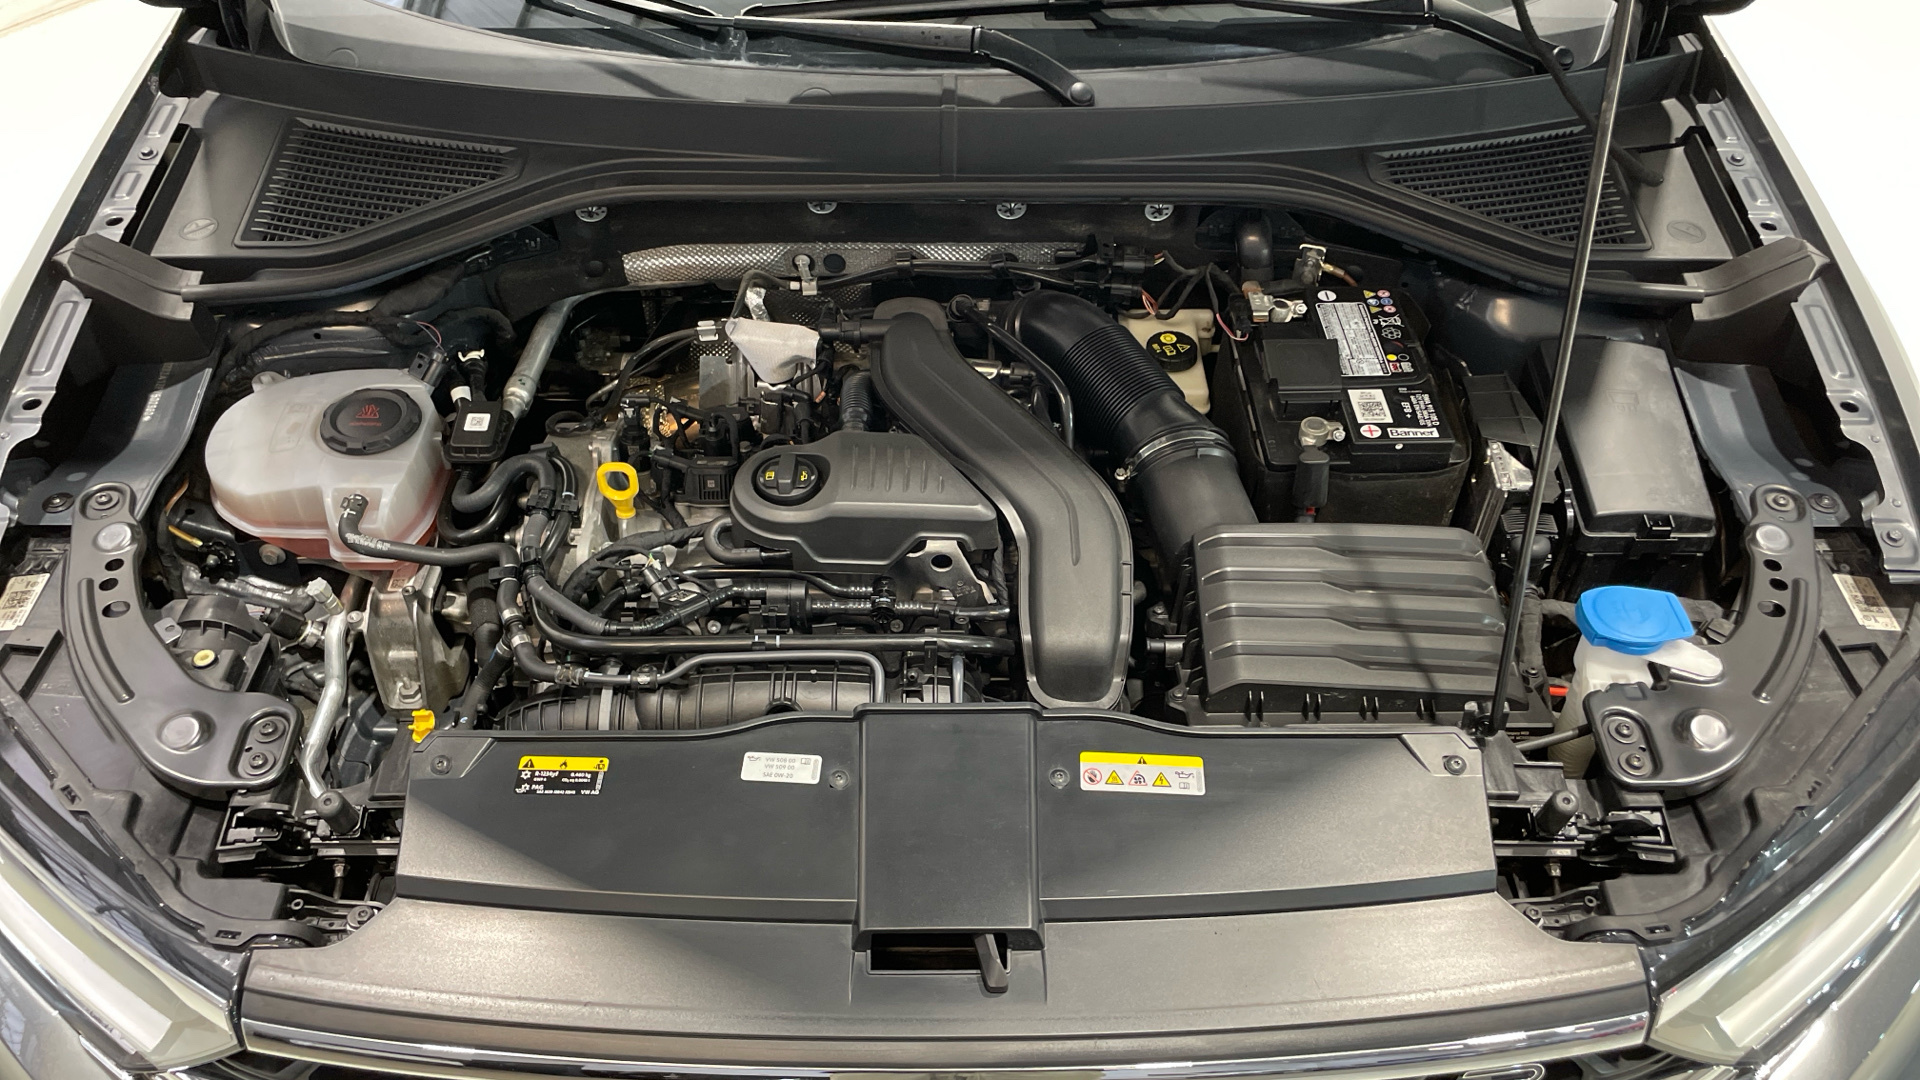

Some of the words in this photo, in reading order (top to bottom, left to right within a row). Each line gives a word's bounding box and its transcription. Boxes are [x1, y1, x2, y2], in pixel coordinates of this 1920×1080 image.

[1401, 402, 1412, 413] EFB
[1389, 429, 1435, 437] Banner
[534, 770, 559, 778] R-1234yf
